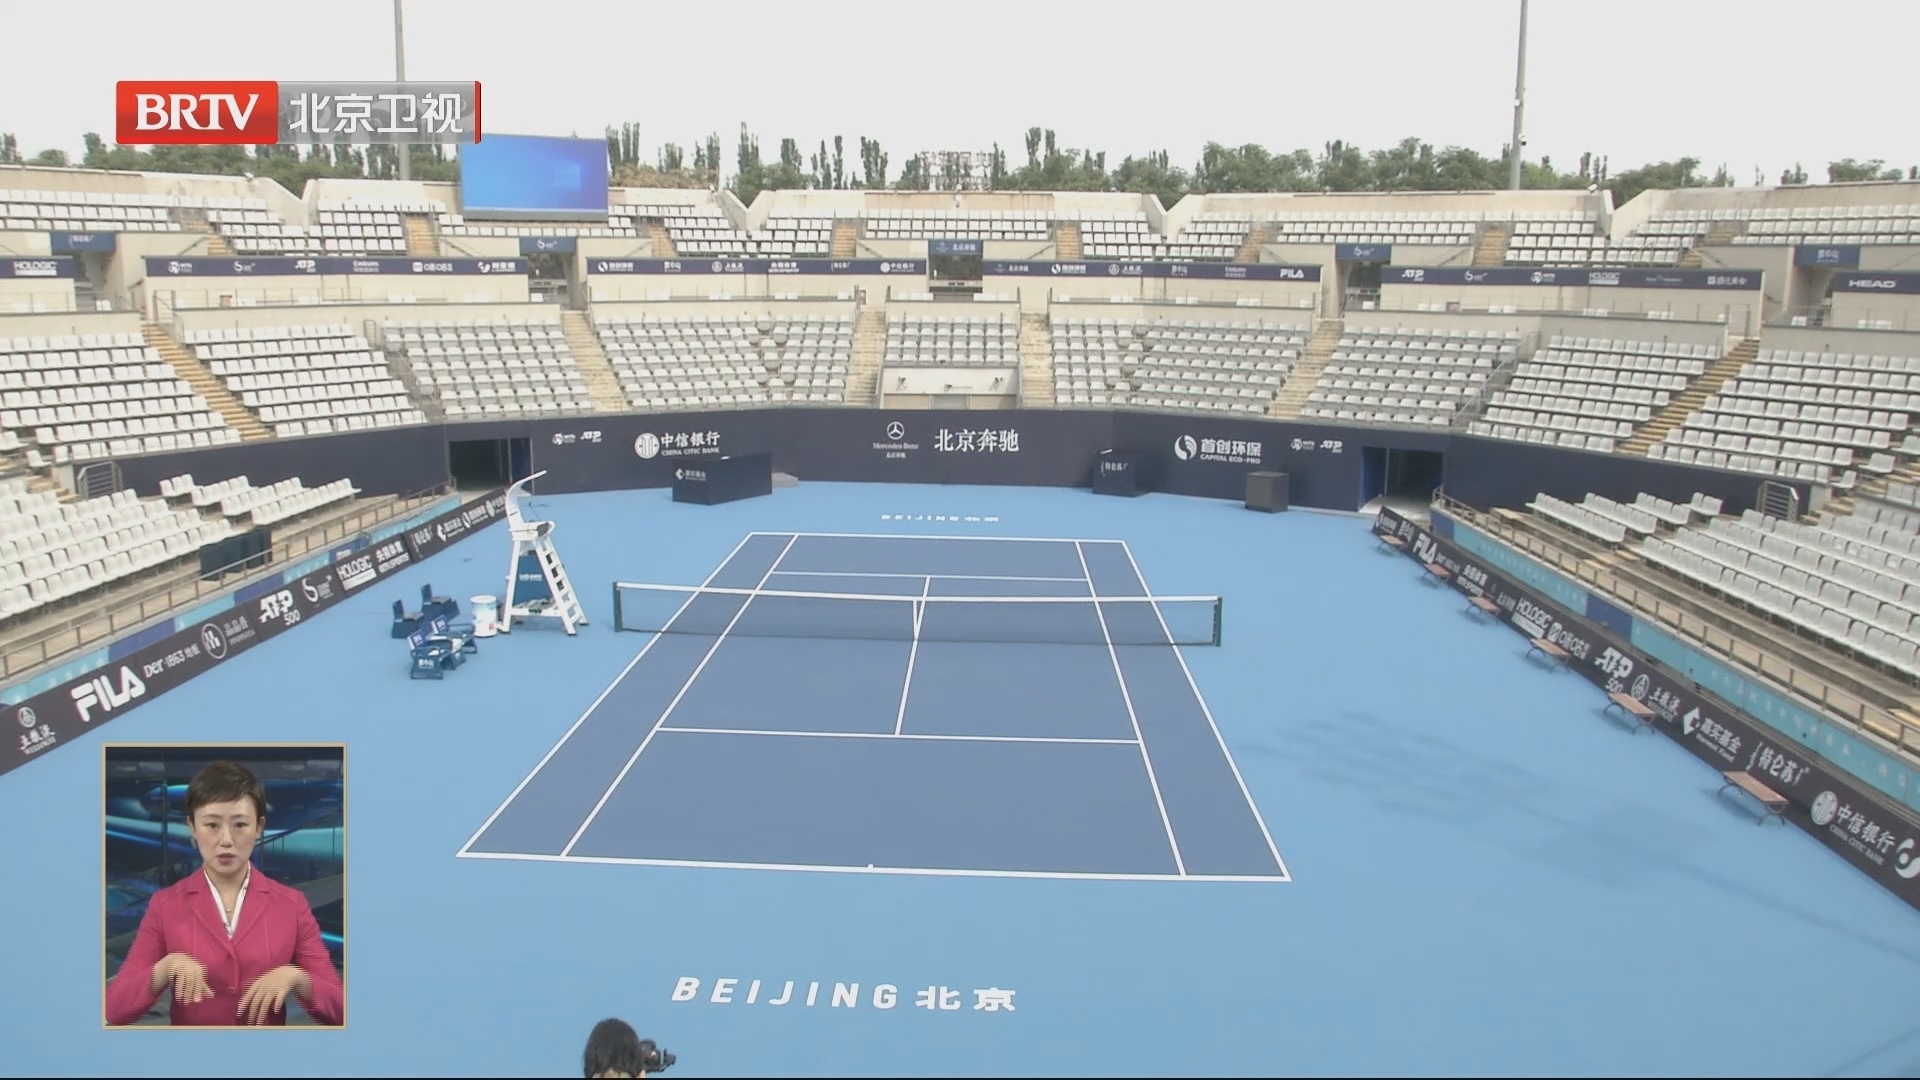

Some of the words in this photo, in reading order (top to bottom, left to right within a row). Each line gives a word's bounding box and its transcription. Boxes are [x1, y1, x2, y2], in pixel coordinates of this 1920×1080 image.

[1280, 268, 1304, 278] FILA
[1849, 280, 1896, 288] HEAD
[661, 431, 721, 448] 中信银行
[702, 446, 720, 454] BANK
[934, 428, 1020, 452] 北京奔驰
[1201, 438, 1262, 457] 首创环保
[1200, 453, 1227, 462] CAPITAL
[1412, 532, 1438, 564] FILA
[336, 555, 373, 580] HOLOGIC
[258, 589, 294, 624] ATP
[283, 609, 301, 626] 500
[1516, 597, 1551, 629] HOLOGIC
[1594, 647, 1634, 680] ATP
[70, 665, 146, 723] FILA
[1605, 678, 1624, 695] 500
[1757, 746, 1796, 783] 特仑苏
[1837, 804, 1897, 854] 中信银行
[671, 976, 898, 1010] BEIJING
[914, 985, 1017, 1011] 北京
